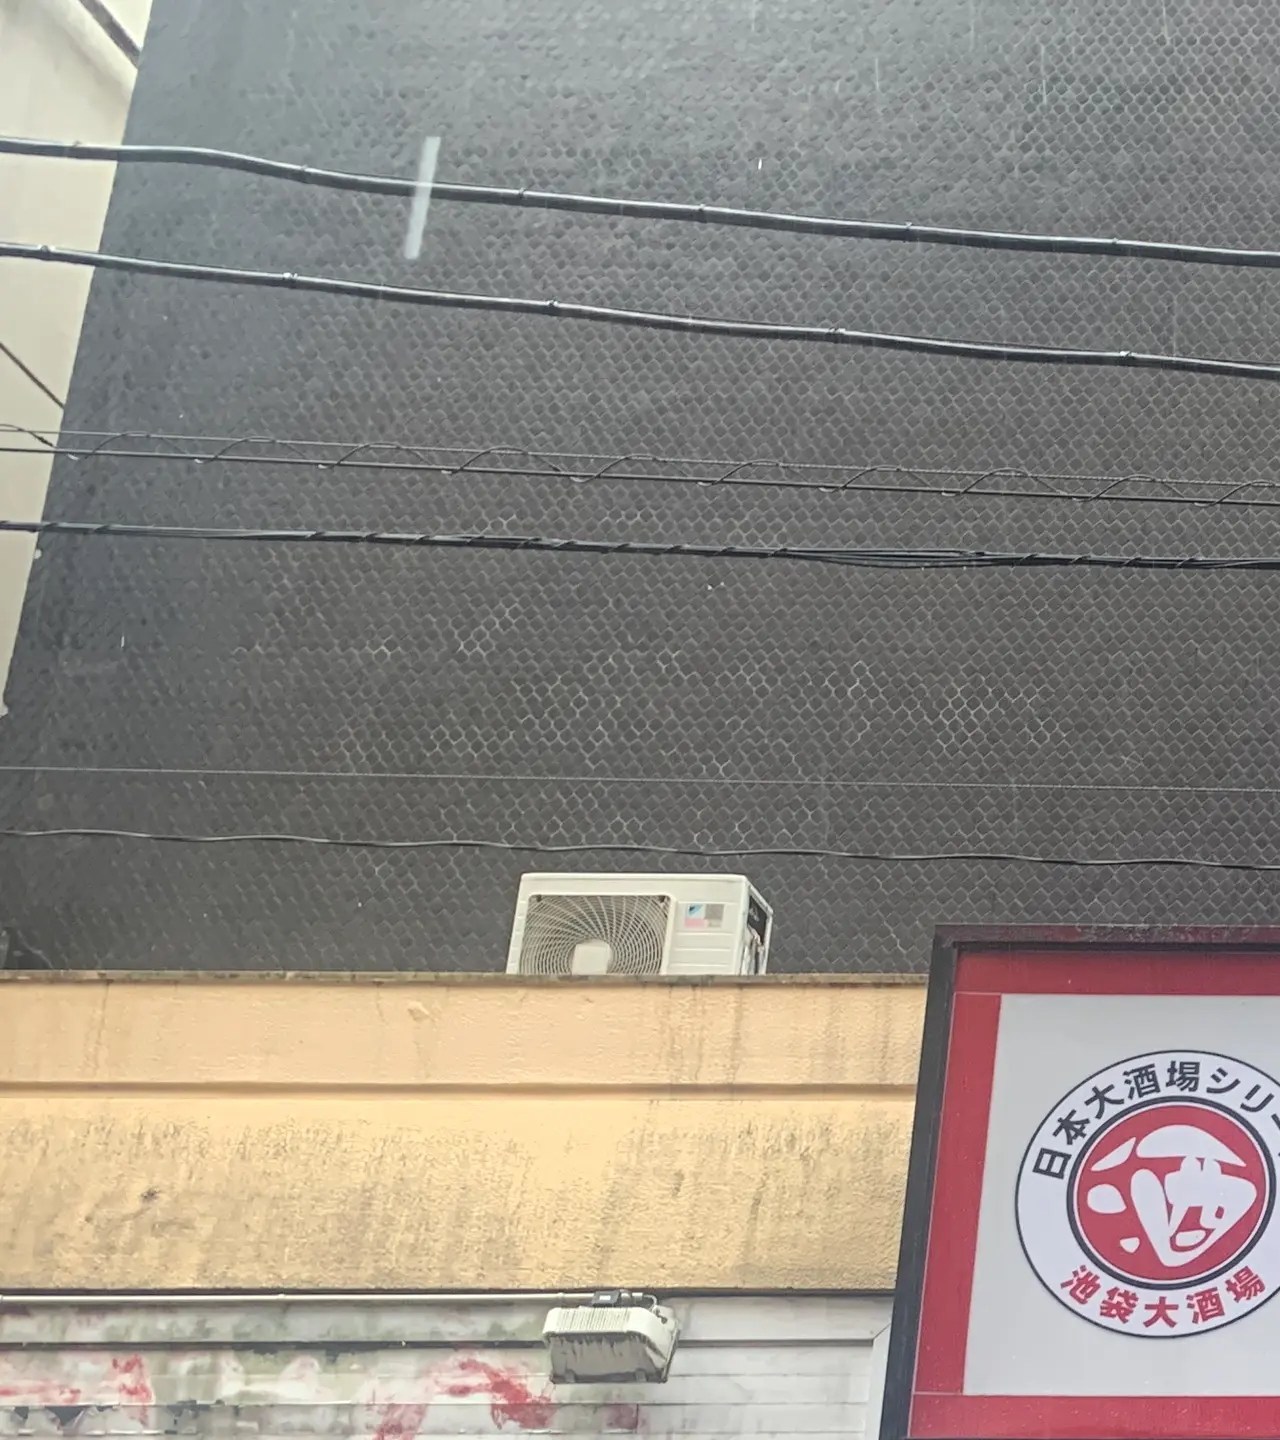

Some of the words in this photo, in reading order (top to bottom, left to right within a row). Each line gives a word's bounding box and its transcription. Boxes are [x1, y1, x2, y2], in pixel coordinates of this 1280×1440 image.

[1060, 1265, 1266, 1328] 池袋大酒場
